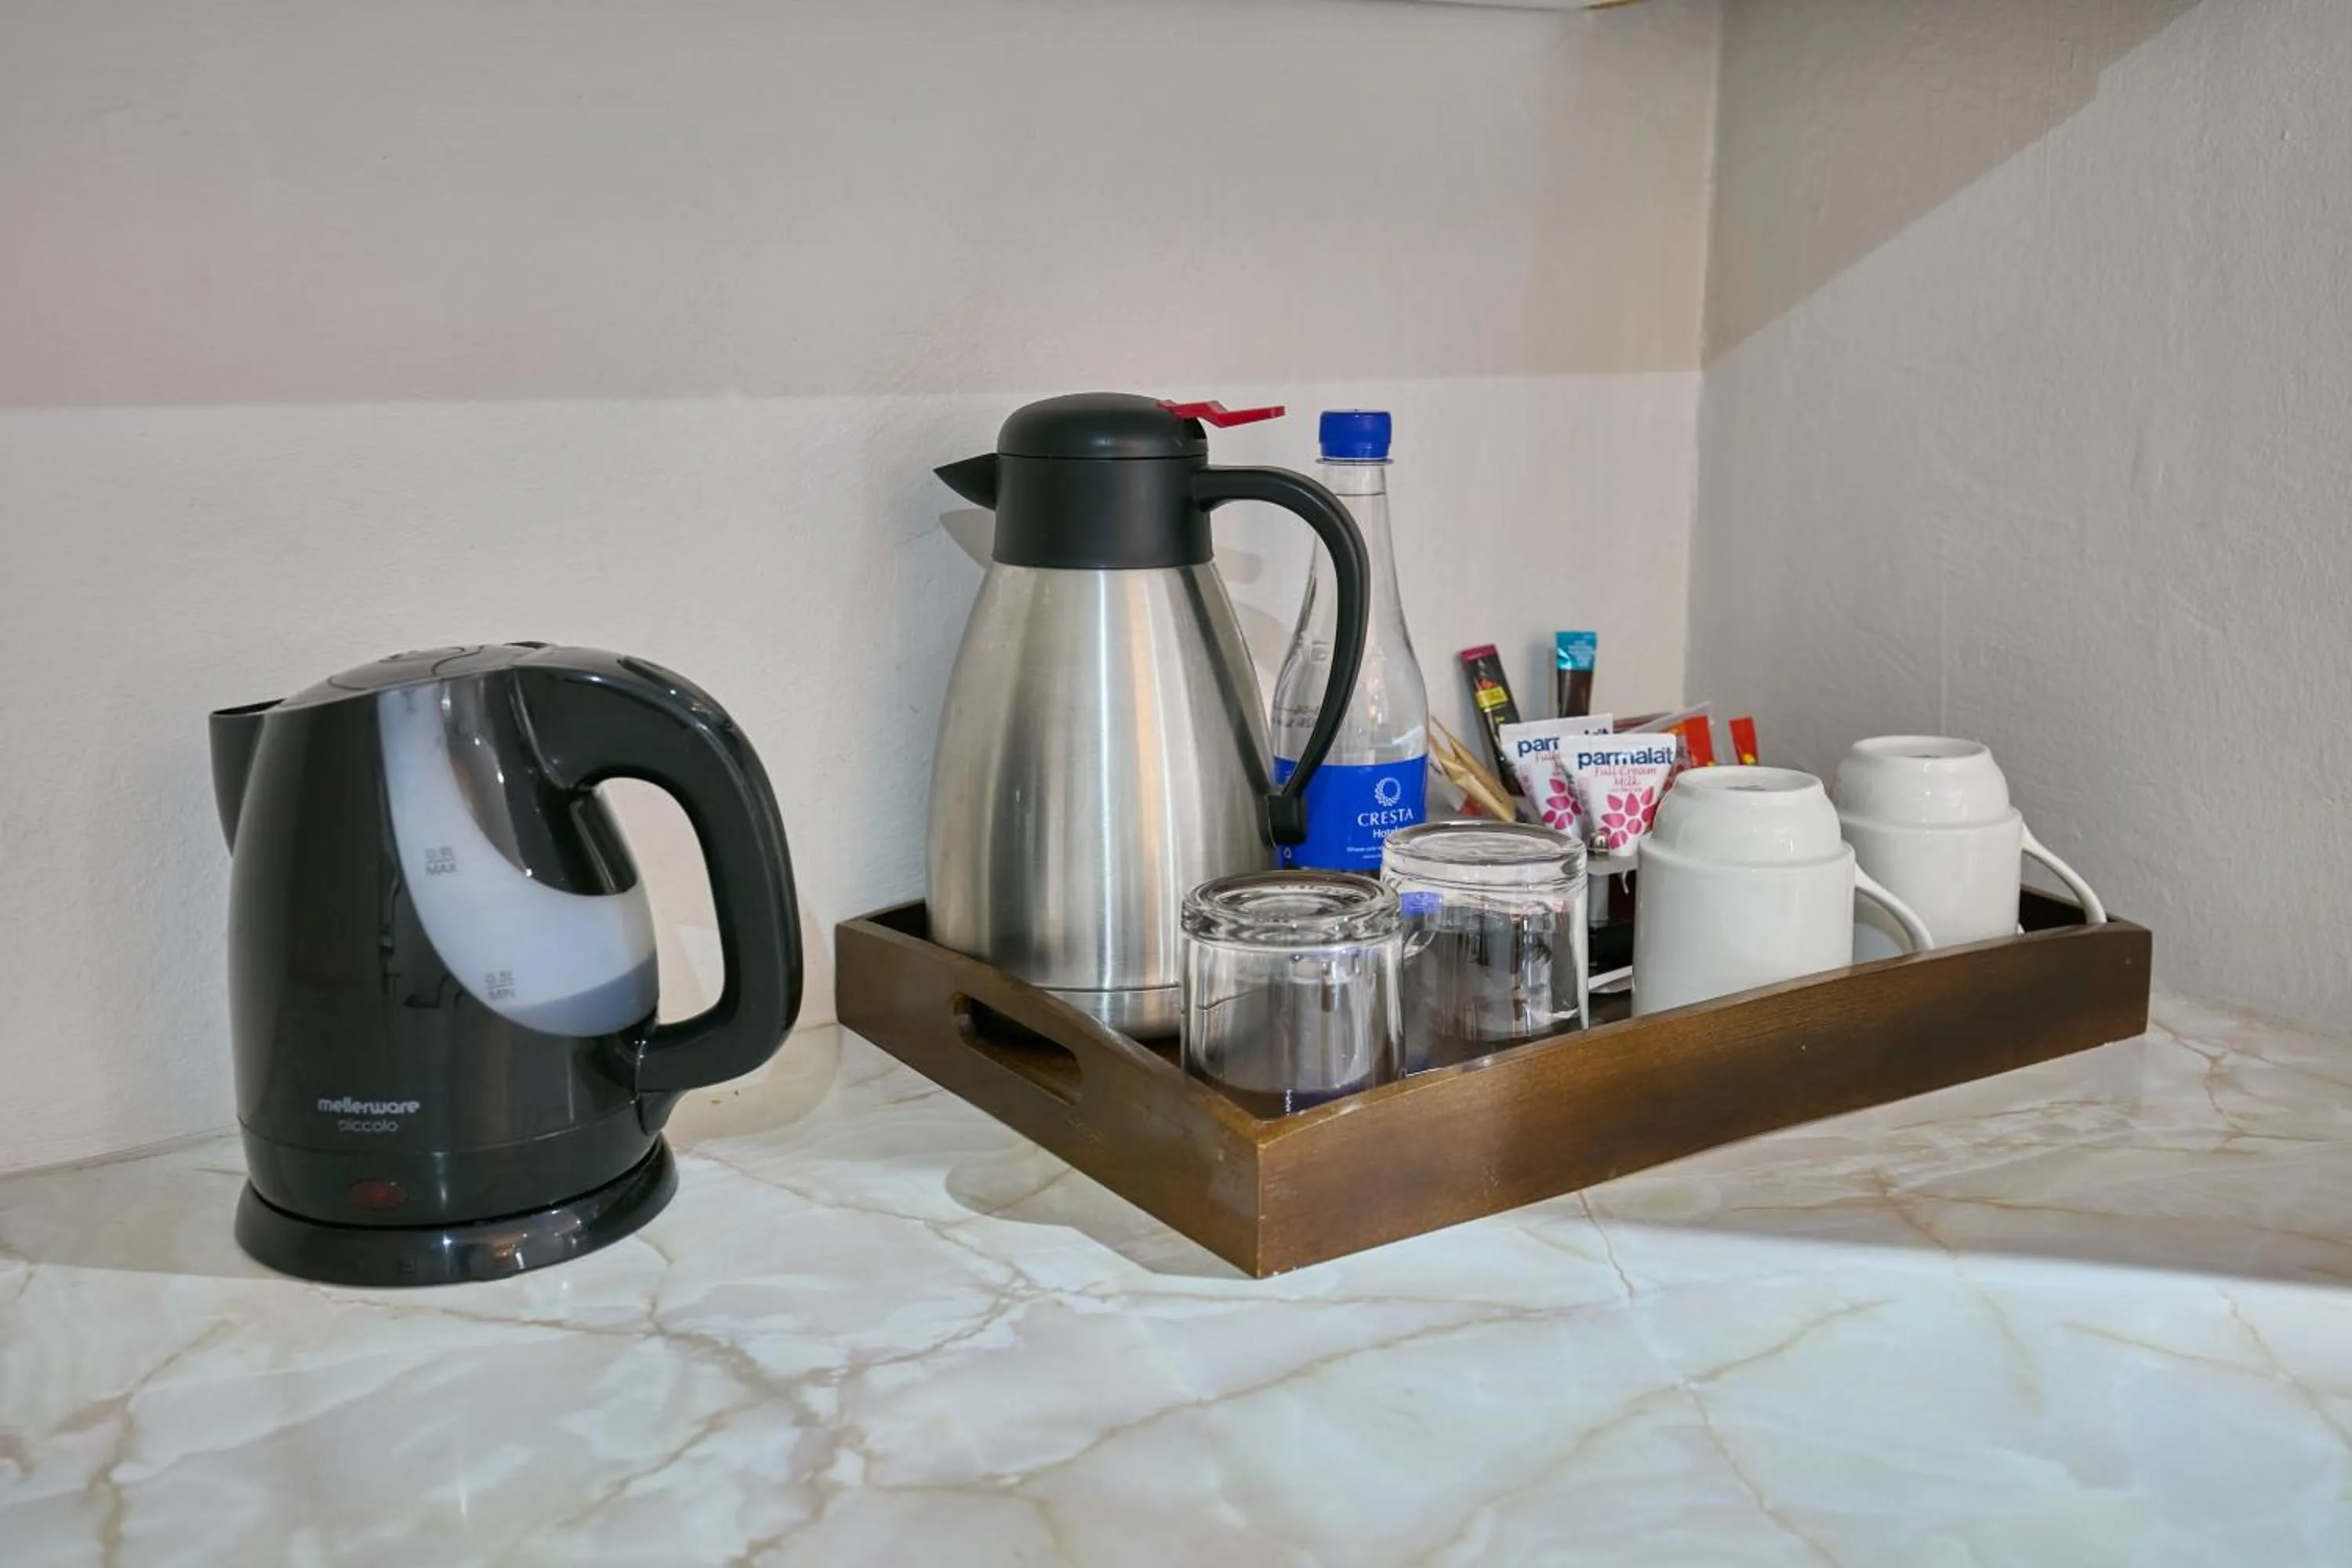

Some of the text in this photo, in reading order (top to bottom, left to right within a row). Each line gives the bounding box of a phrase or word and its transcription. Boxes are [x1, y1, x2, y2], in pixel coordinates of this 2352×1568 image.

[1577, 746, 1674, 769] parmalat
[1593, 765, 1657, 777] Full Cream
[1357, 808, 1414, 827] CRESTA
[426, 863, 456, 877] MAX
[488, 989, 516, 1001] MIN
[318, 1096, 421, 1114] mellerware
